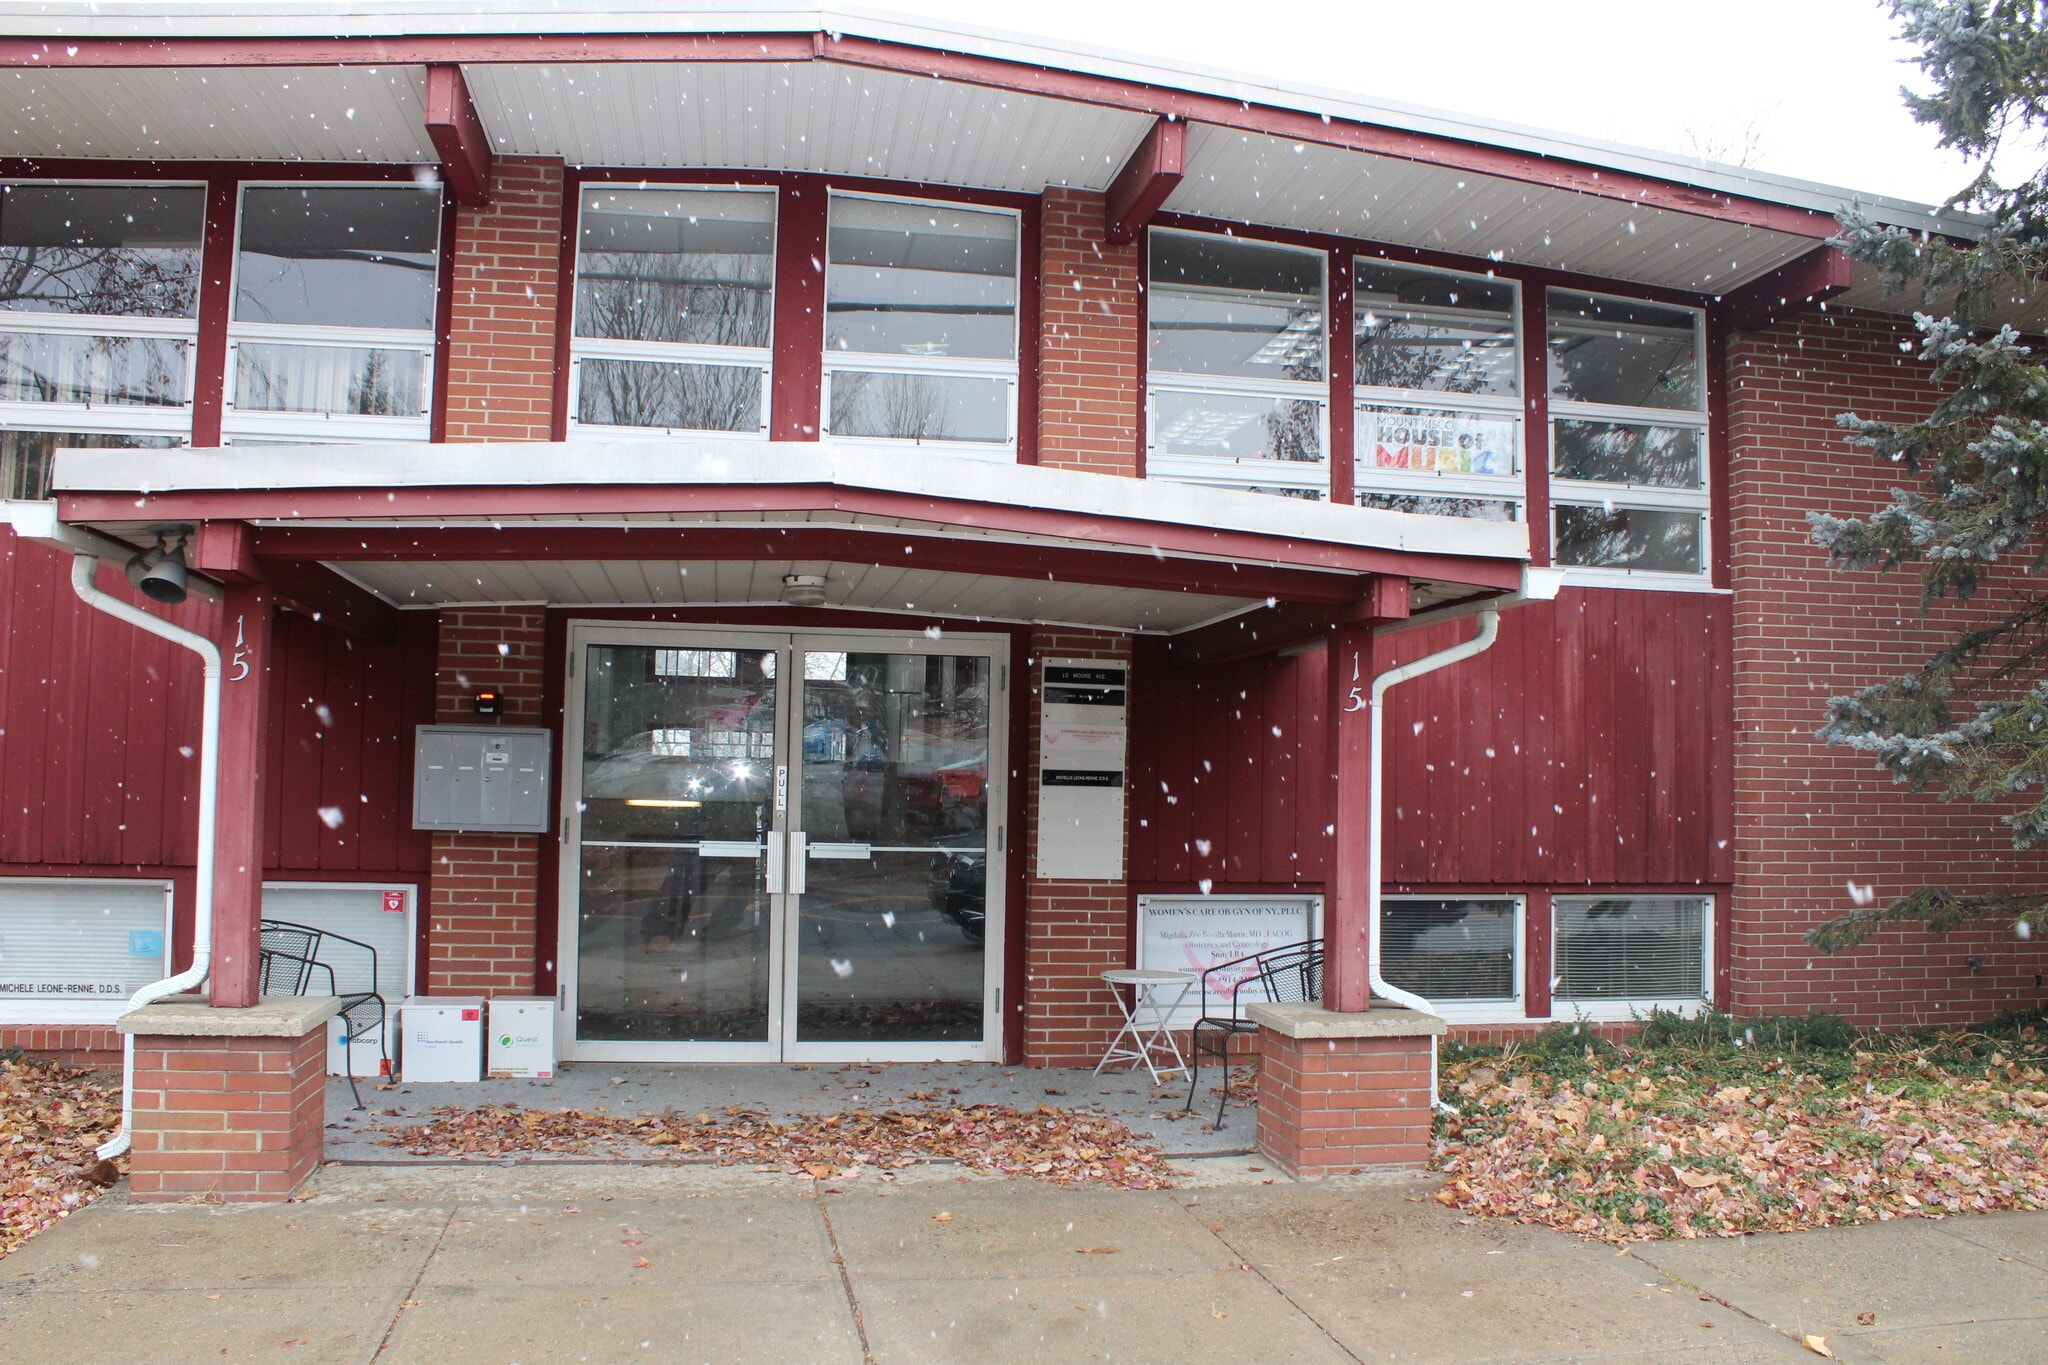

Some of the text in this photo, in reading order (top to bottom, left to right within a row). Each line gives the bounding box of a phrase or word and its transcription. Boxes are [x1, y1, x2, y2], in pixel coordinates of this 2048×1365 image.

[1377, 416, 1456, 430] MOUNT KISCO
[1377, 426, 1454, 447] HOUSE
[1376, 444, 1495, 475] MUSIC
[229, 614, 250, 681] 15
[1343, 651, 1362, 712] 15
[1149, 907, 1191, 916] WOMEN'S
[1192, 908, 1217, 916] CARE
[1232, 908, 1251, 916] GYN
[1265, 908, 1280, 916] NY,
[1281, 907, 1303, 915] PLLC
[1185, 941, 1218, 949] Obstetrics
[1232, 941, 1269, 950] Gynecology
[0, 983, 122, 994] MICHELE LEONE-RENNE, D.D.S.
